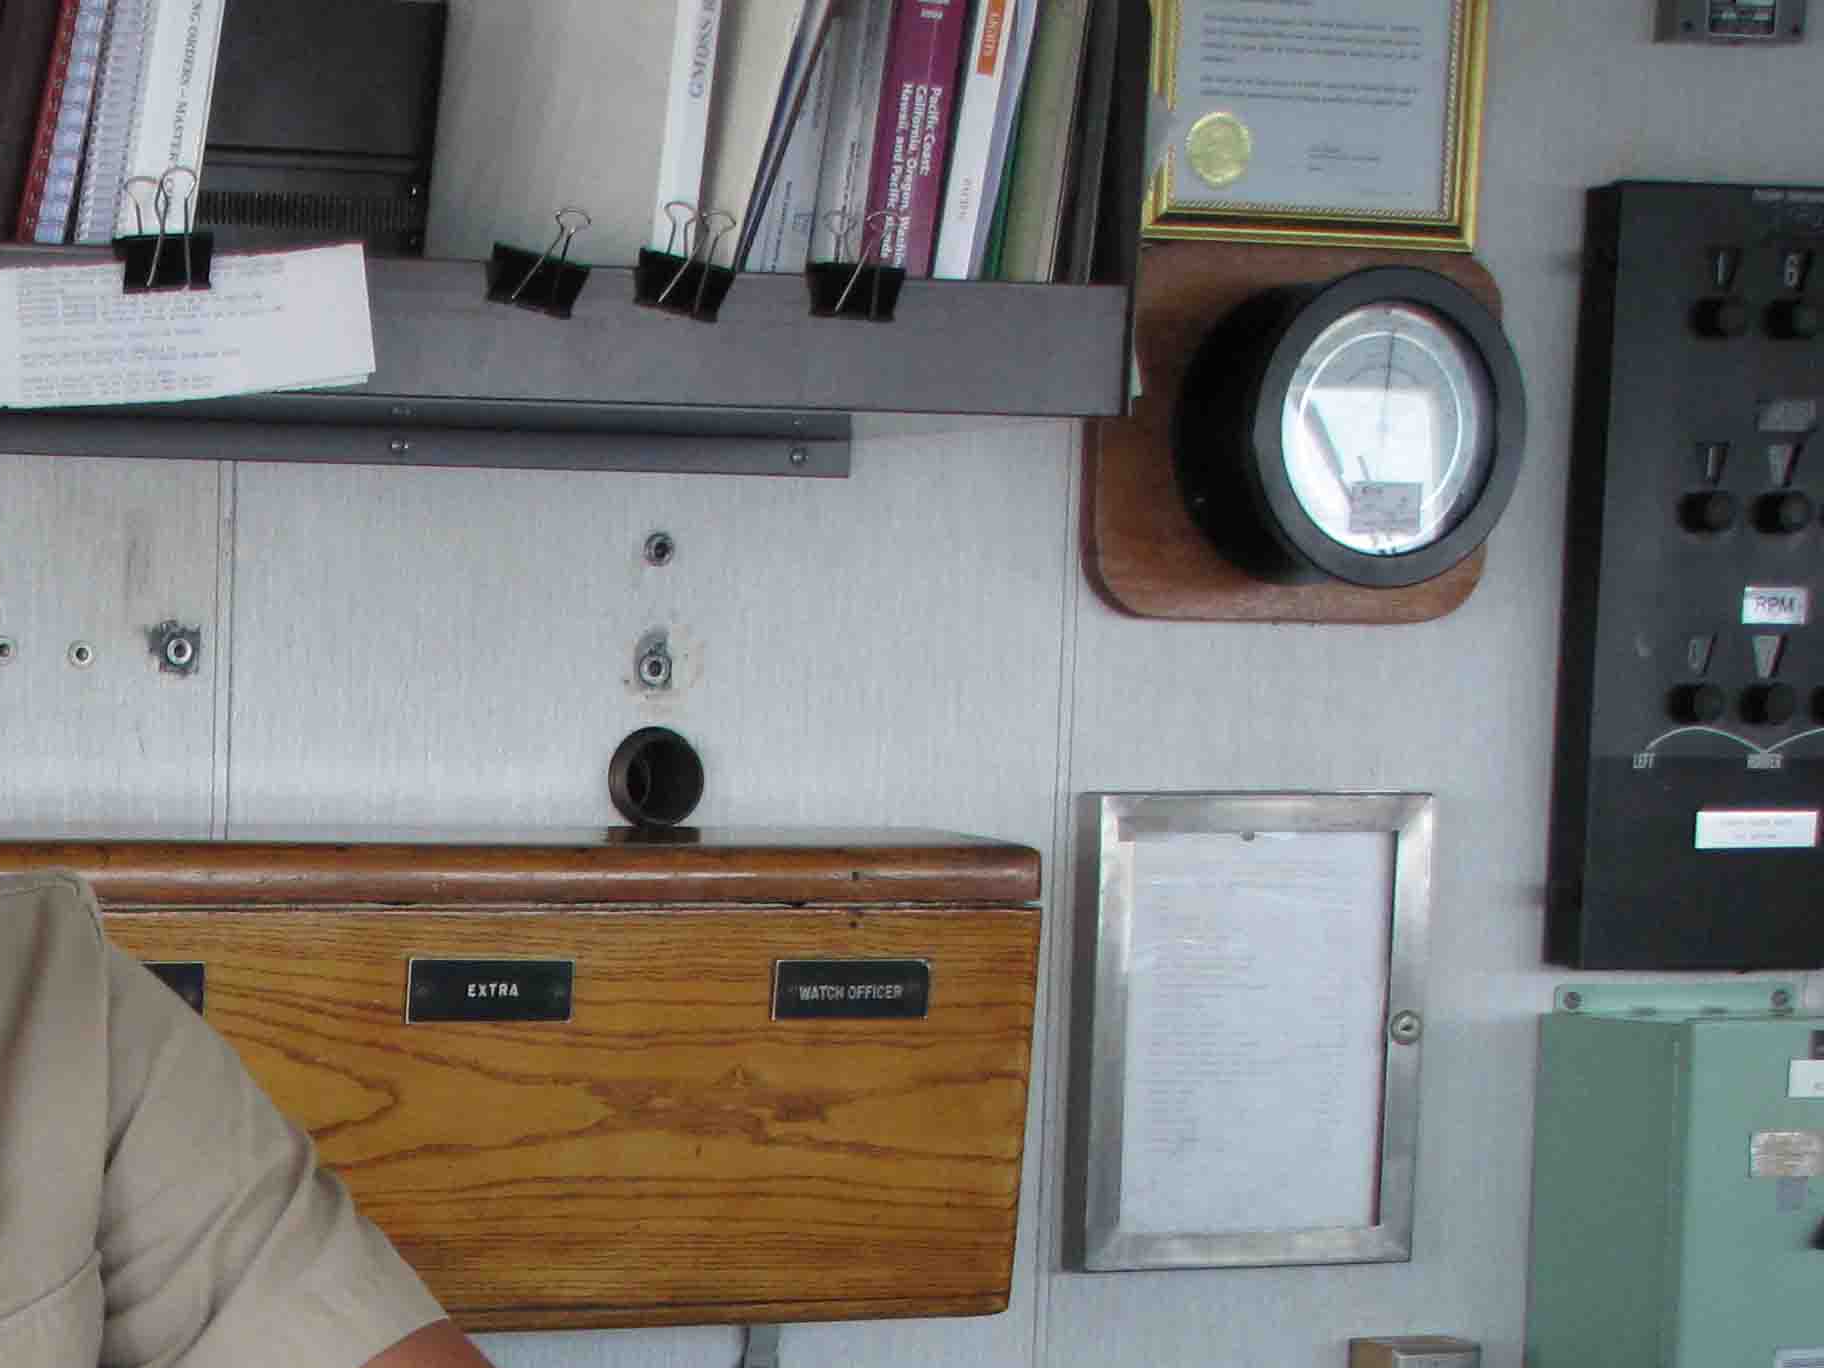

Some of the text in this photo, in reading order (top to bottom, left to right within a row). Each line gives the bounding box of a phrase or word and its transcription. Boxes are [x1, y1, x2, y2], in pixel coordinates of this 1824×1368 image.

[925, 87, 943, 132] Pacific
[892, 135, 905, 163] and
[886, 164, 903, 209] Pacific
[467, 983, 520, 998] EXTRA
[799, 983, 904, 1001] WATCH OFFICER
